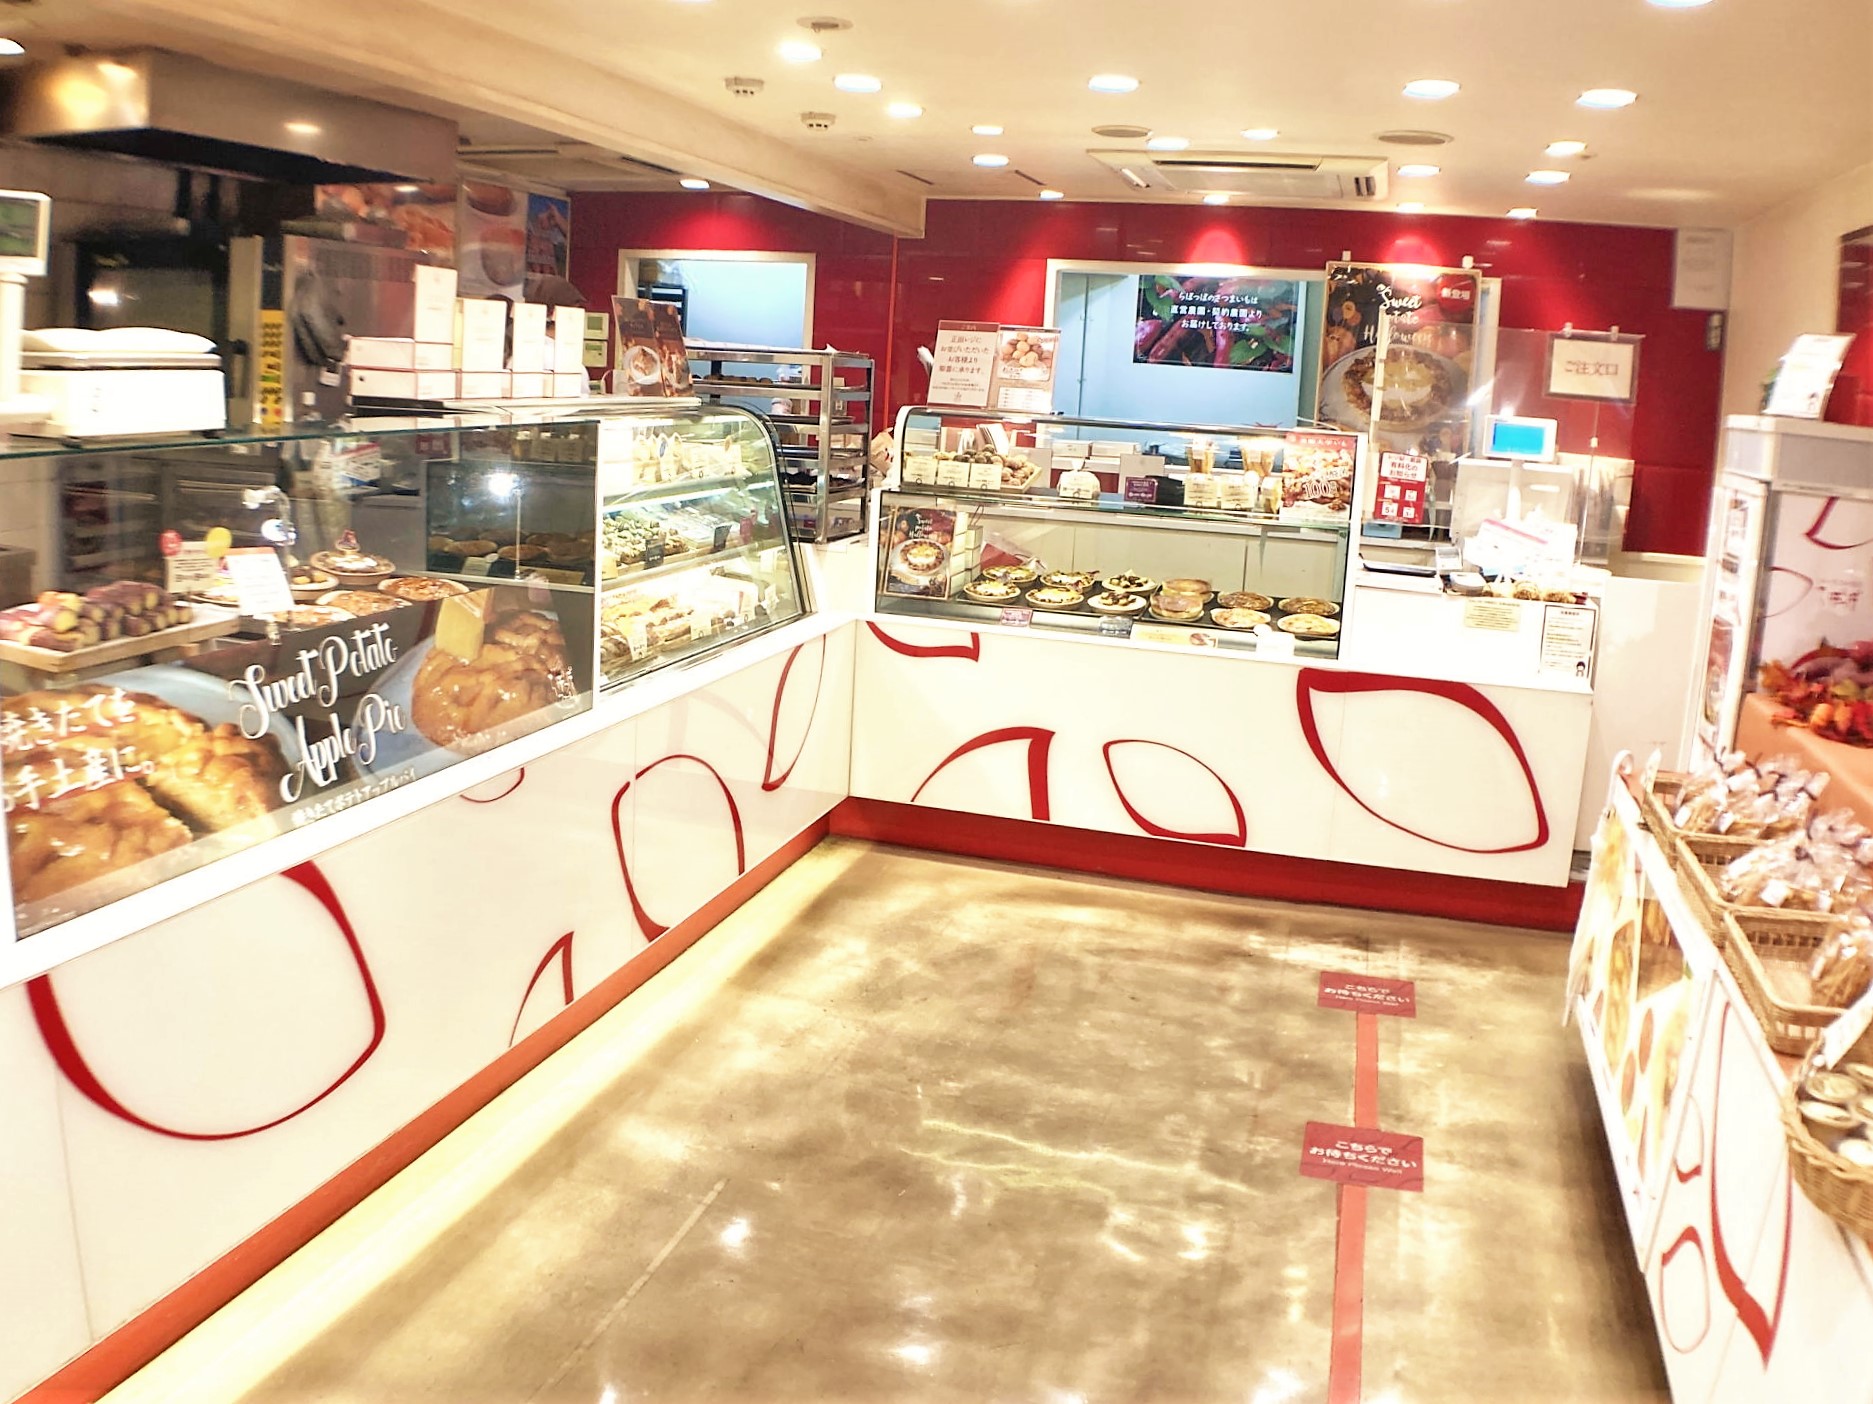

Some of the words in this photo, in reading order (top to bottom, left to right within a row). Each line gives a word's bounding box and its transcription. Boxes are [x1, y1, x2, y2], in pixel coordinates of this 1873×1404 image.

[1377, 284, 1422, 310] Sweet
[228, 648, 320, 740] Sweet
[318, 621, 399, 708] Potato
[279, 712, 358, 803] Apple
[358, 692, 406, 766] Pie
[1324, 987, 1410, 1003] お待ちください
[1309, 1146, 1417, 1168] お待ちください
[1335, 1141, 1393, 1156] こちらで
